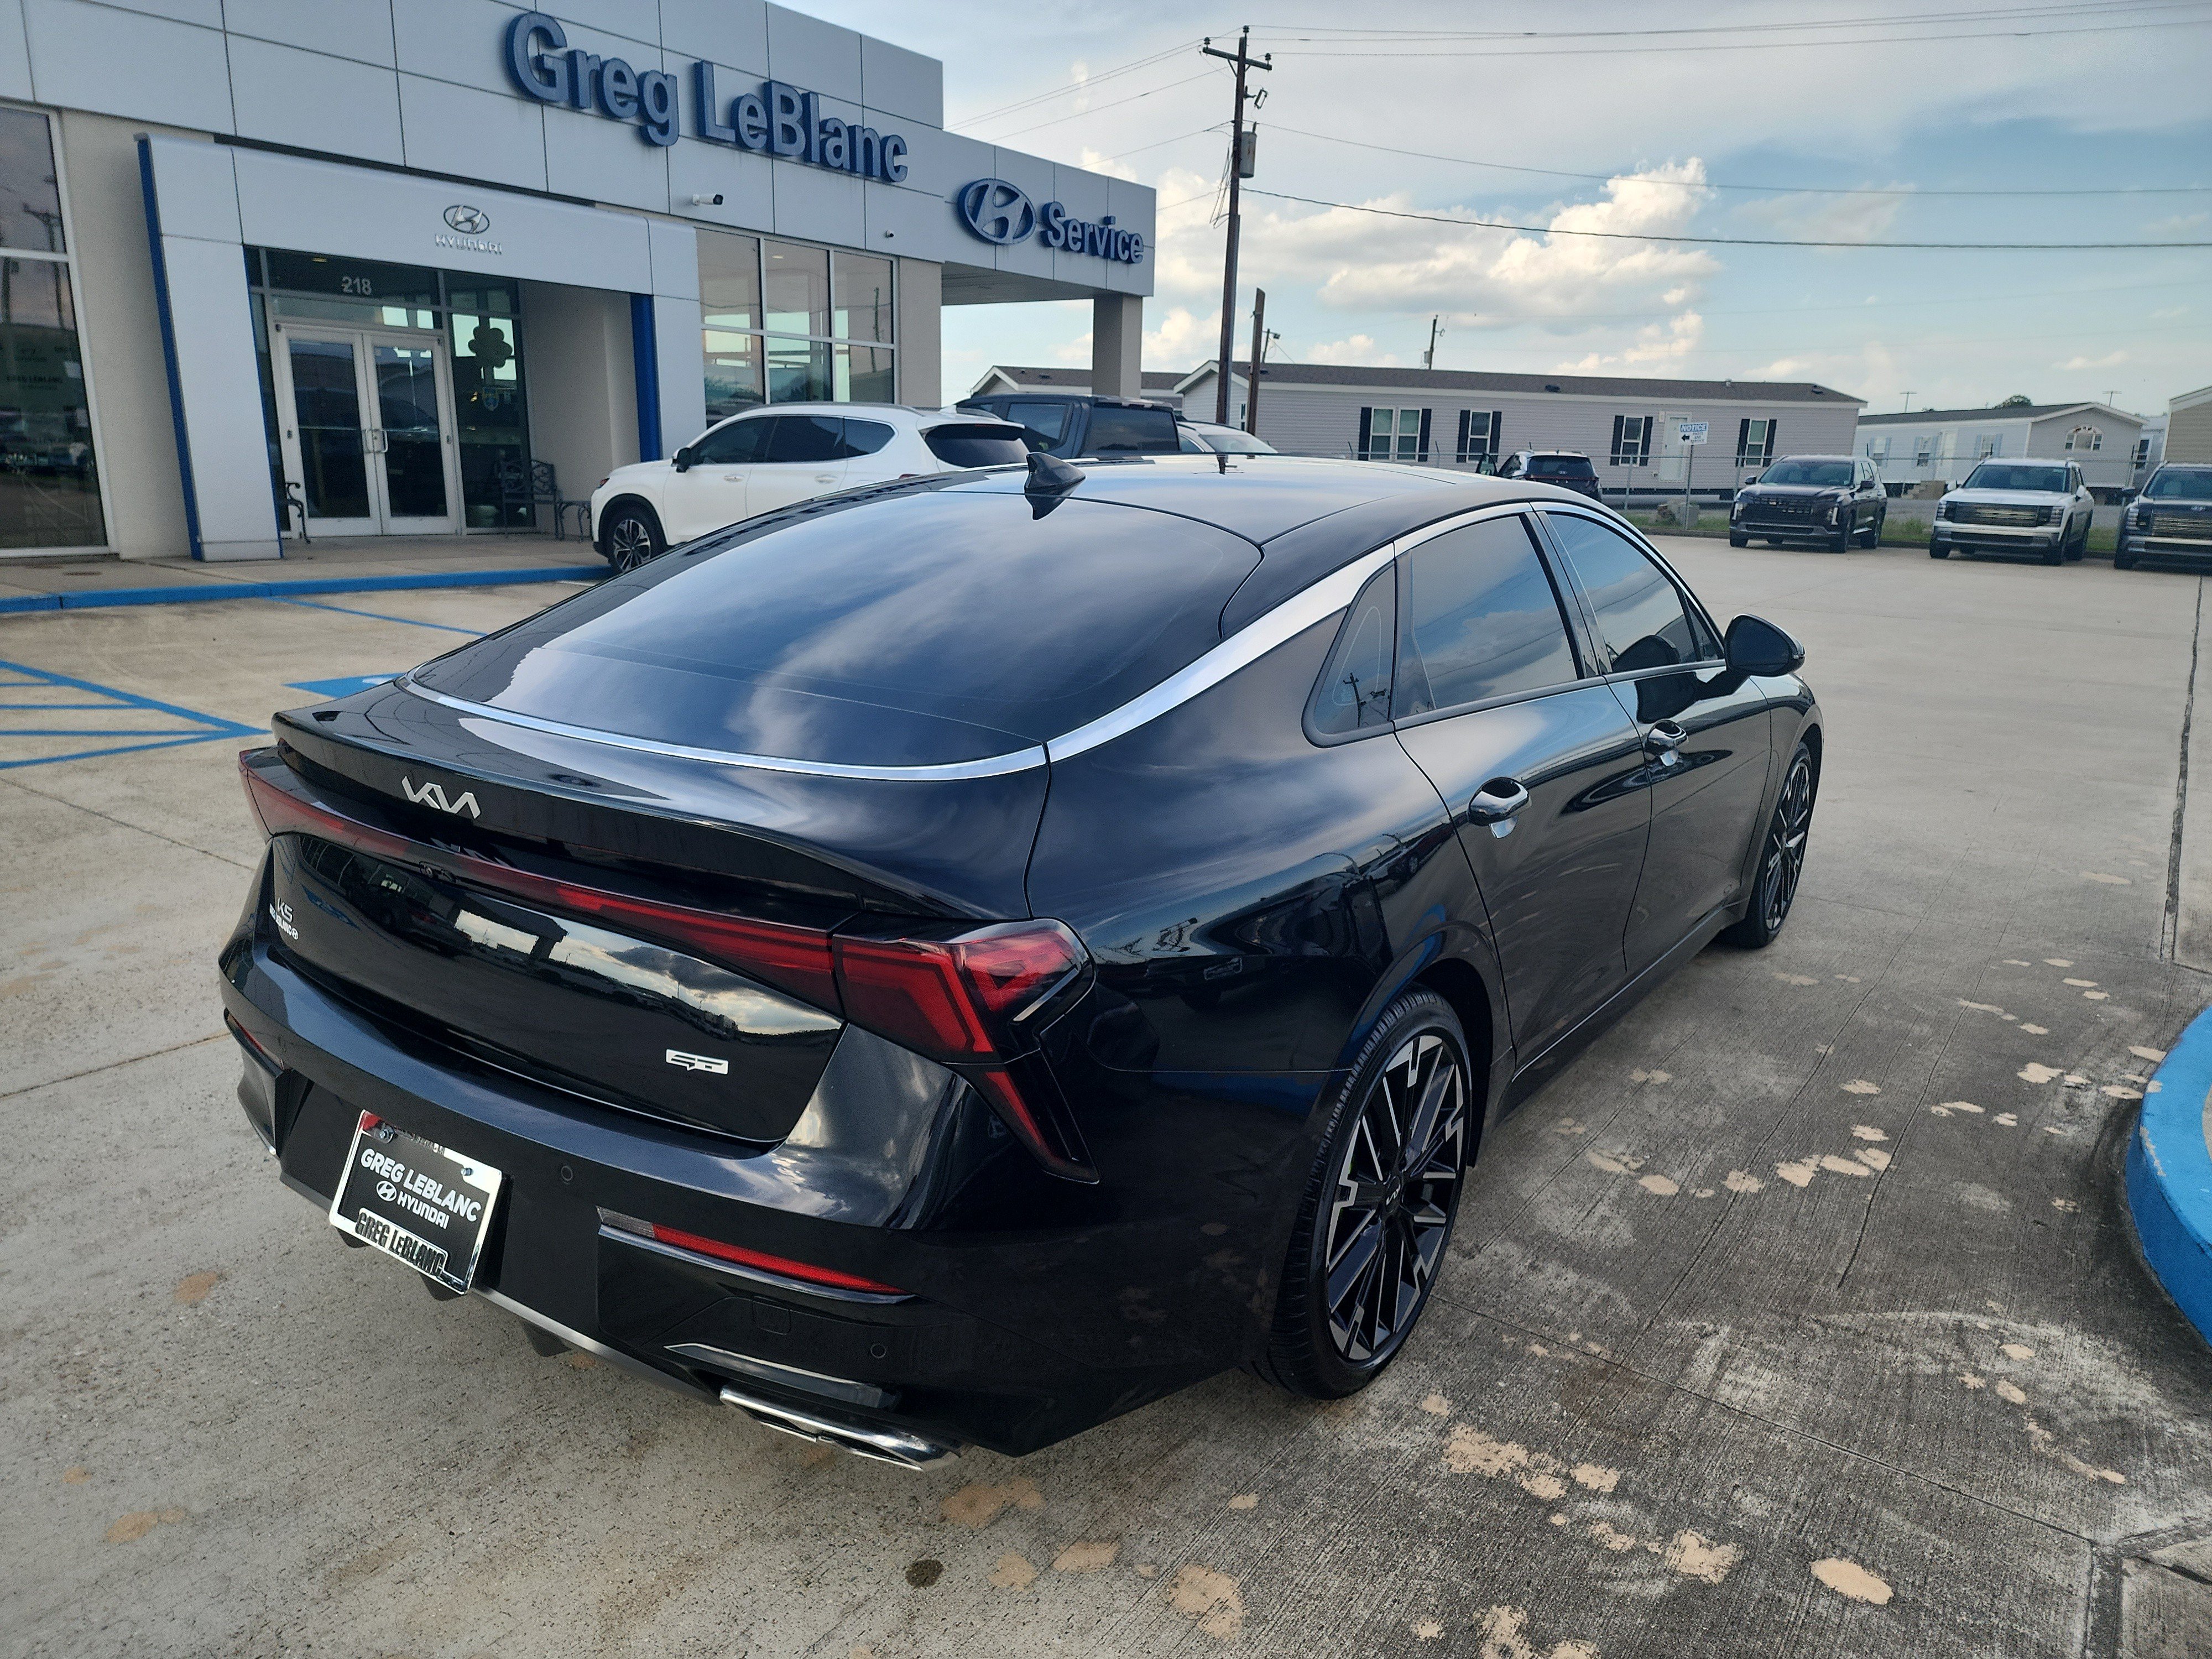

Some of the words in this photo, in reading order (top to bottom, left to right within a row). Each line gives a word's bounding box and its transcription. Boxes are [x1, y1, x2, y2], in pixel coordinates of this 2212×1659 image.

[505, 12, 680, 147] Greg
[694, 60, 908, 182] LeBlanc
[435, 233, 502, 255] HYUNDAI
[1040, 201, 1144, 264] Service
[341, 276, 372, 295] 218
[1681, 424, 1707, 432] NOTICE
[401, 775, 481, 819] KIA
[277, 897, 293, 923] K5
[361, 1148, 406, 1183] GREG
[403, 1168, 482, 1222] LEBLANC
[397, 1191, 450, 1230] HYUNDAI
[355, 1212, 390, 1248] GREG
[388, 1229, 446, 1277] LEBLANC
